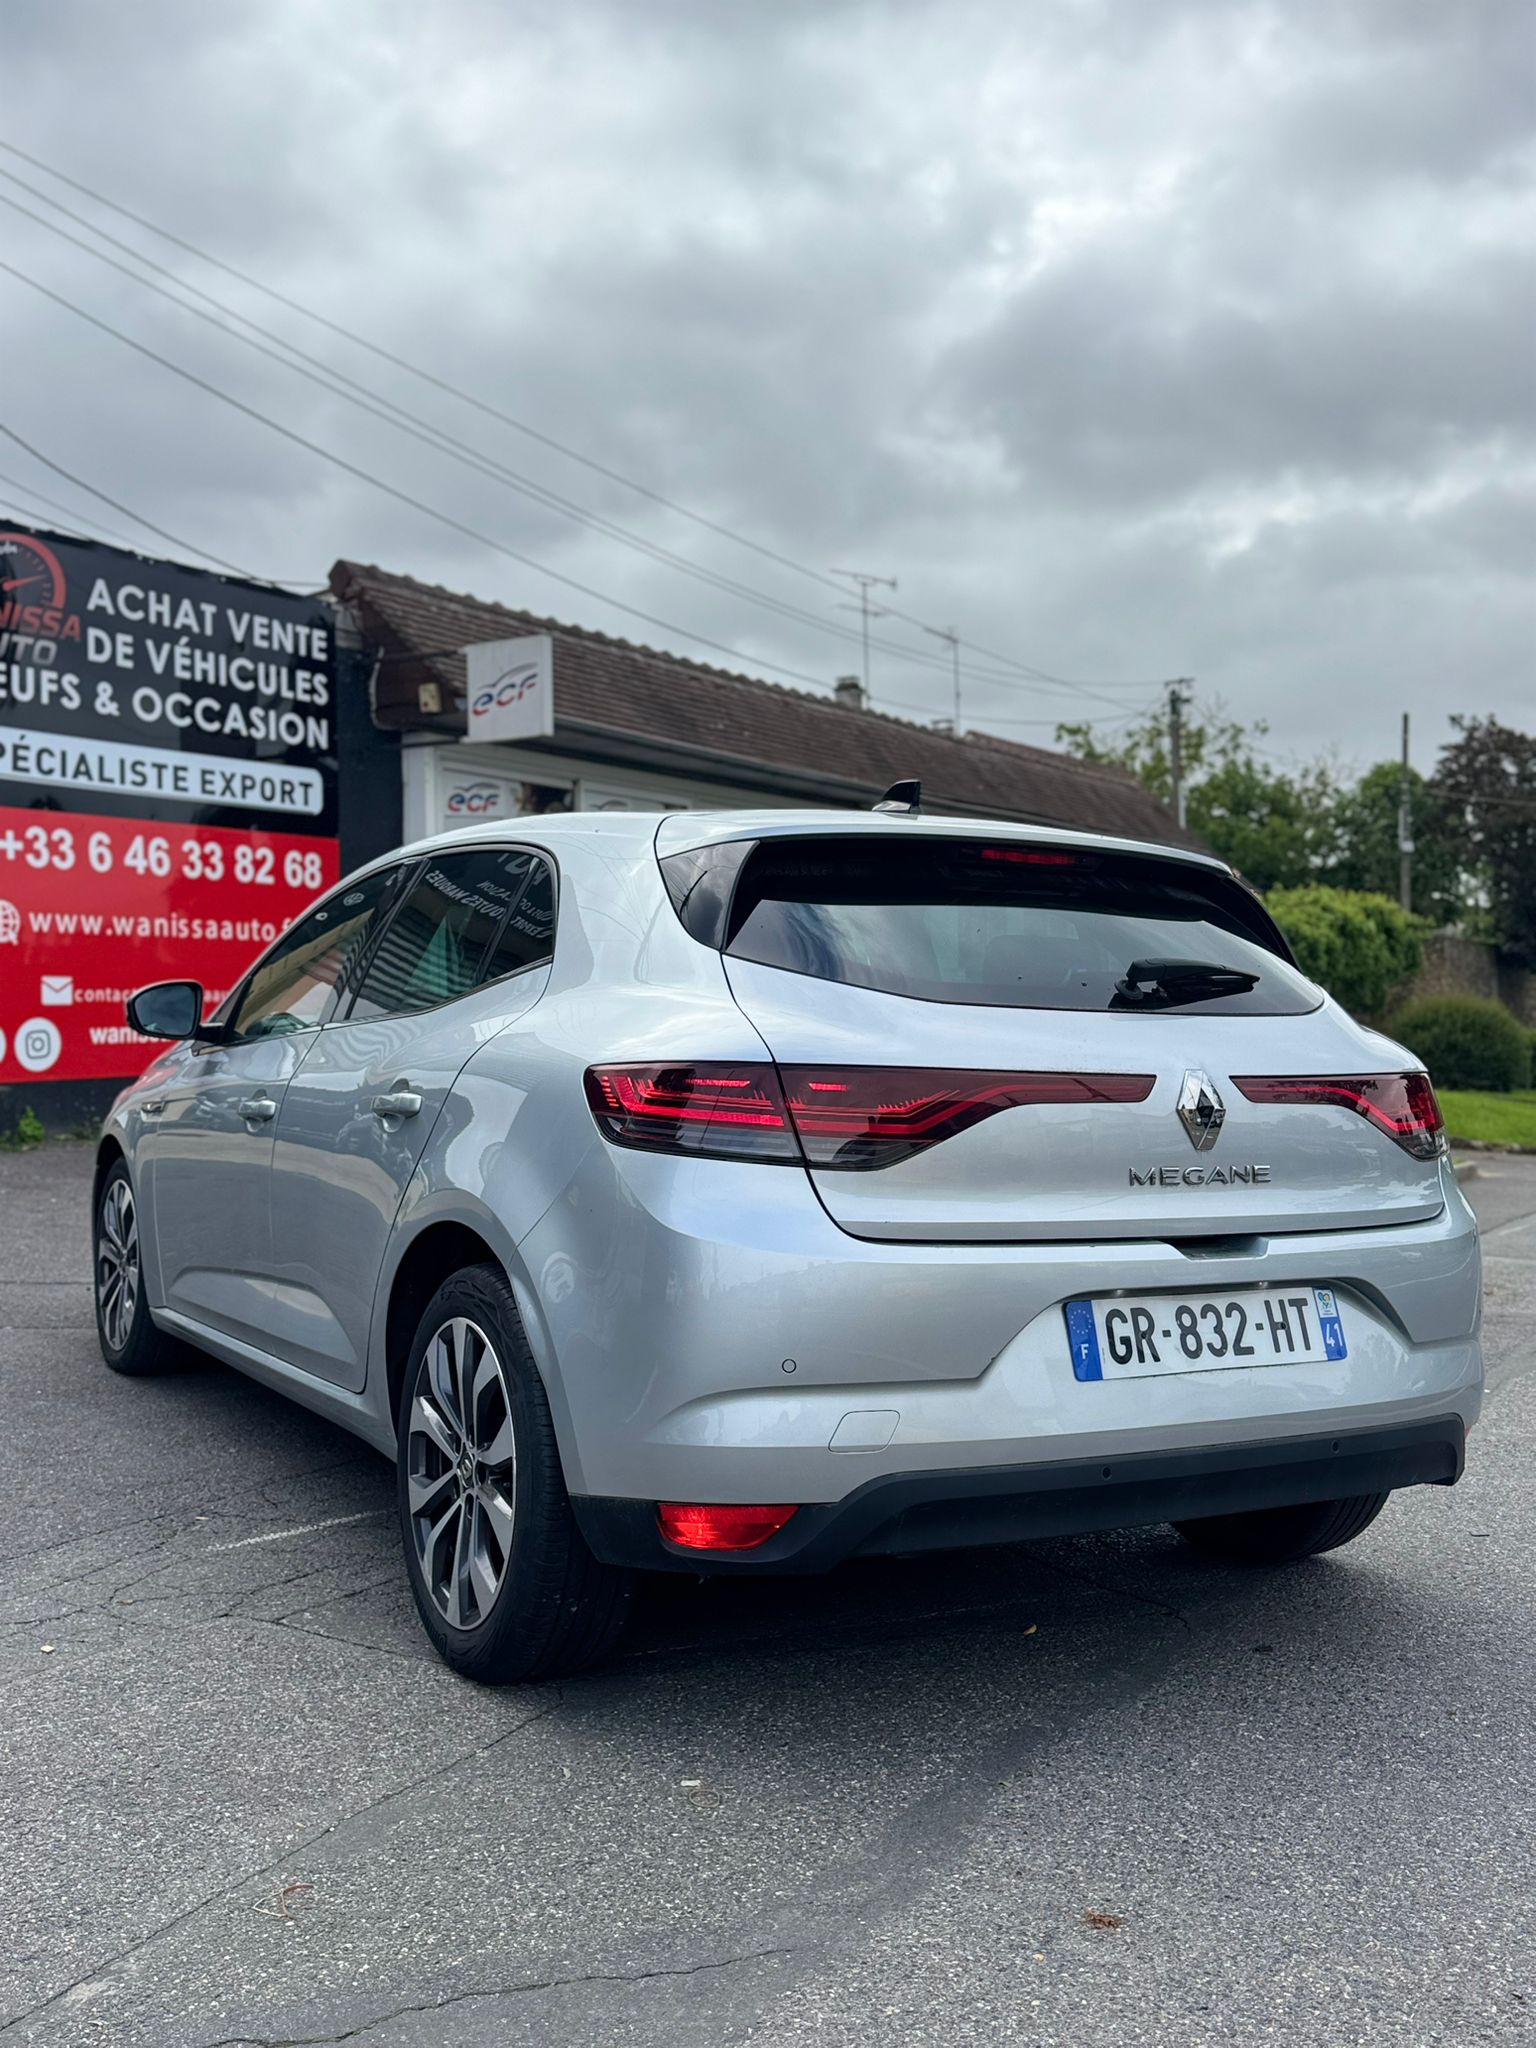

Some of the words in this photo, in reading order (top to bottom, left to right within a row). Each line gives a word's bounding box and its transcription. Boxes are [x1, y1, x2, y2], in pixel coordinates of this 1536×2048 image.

[87, 578, 216, 637] ACHAT
[227, 608, 329, 661] VENTE
[87, 627, 134, 670] DE
[146, 637, 329, 707] VÉHICULES
[95, 682, 120, 717] &
[132, 687, 329, 750] OCCASION
[200, 768, 314, 807] EXPORT
[0, 826, 76, 871] +33
[88, 832, 113, 873] 6
[124, 834, 172, 877] 46
[181, 840, 225, 881] 33
[234, 844, 275, 885] 82
[284, 850, 322, 890] 68
[1128, 1164, 1272, 1187] MEGANE
[1080, 1343, 1091, 1360] F
[1105, 1297, 1312, 1365] GR-832-HT
[1326, 1322, 1343, 1348] 41
